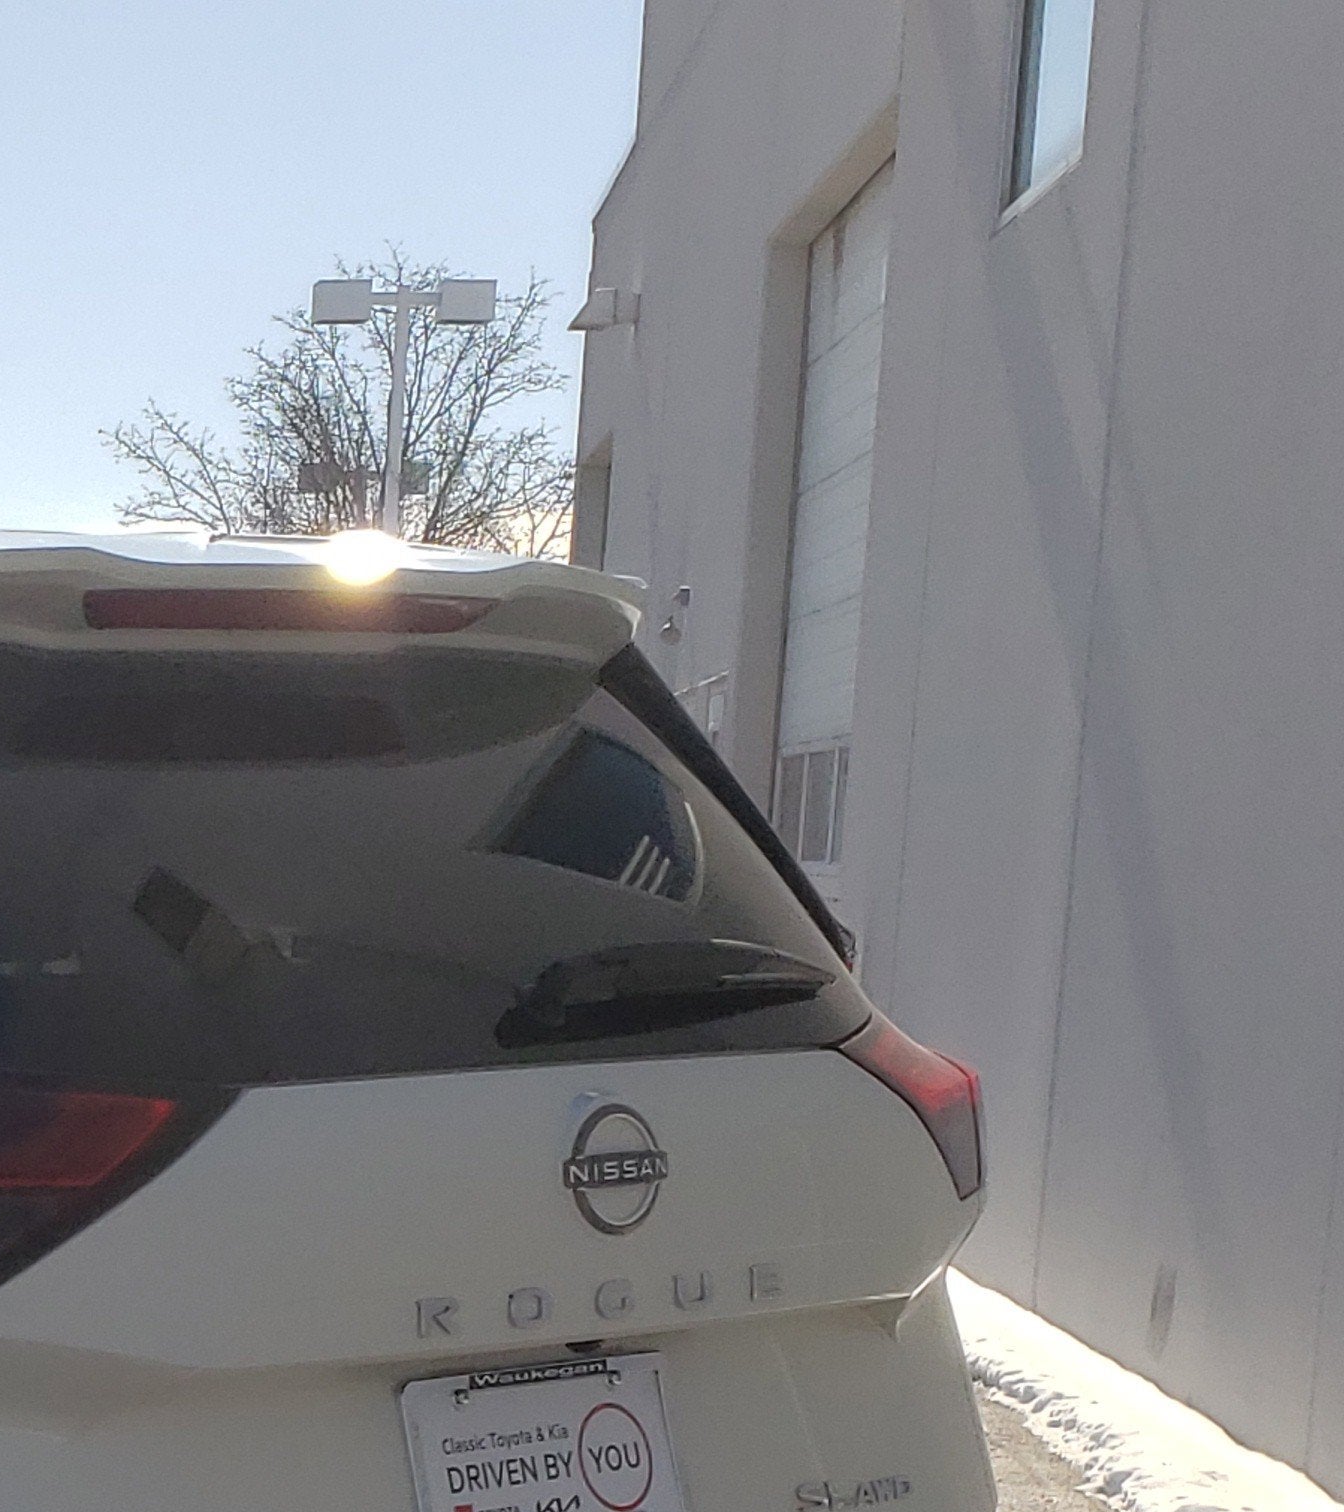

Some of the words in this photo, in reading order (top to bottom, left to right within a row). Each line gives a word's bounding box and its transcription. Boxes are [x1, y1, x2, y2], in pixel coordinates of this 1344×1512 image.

[569, 1158, 667, 1184] NISSAN
[415, 1262, 785, 1339] ROGUE
[474, 1362, 603, 1387] Waukegan
[442, 1436, 486, 1456] Classic
[487, 1429, 532, 1449] Toyota
[536, 1426, 545, 1442] &
[548, 1423, 569, 1440] Kia
[446, 1455, 538, 1494] DRIVEN
[543, 1450, 572, 1480] BY
[588, 1441, 640, 1473] YOU
